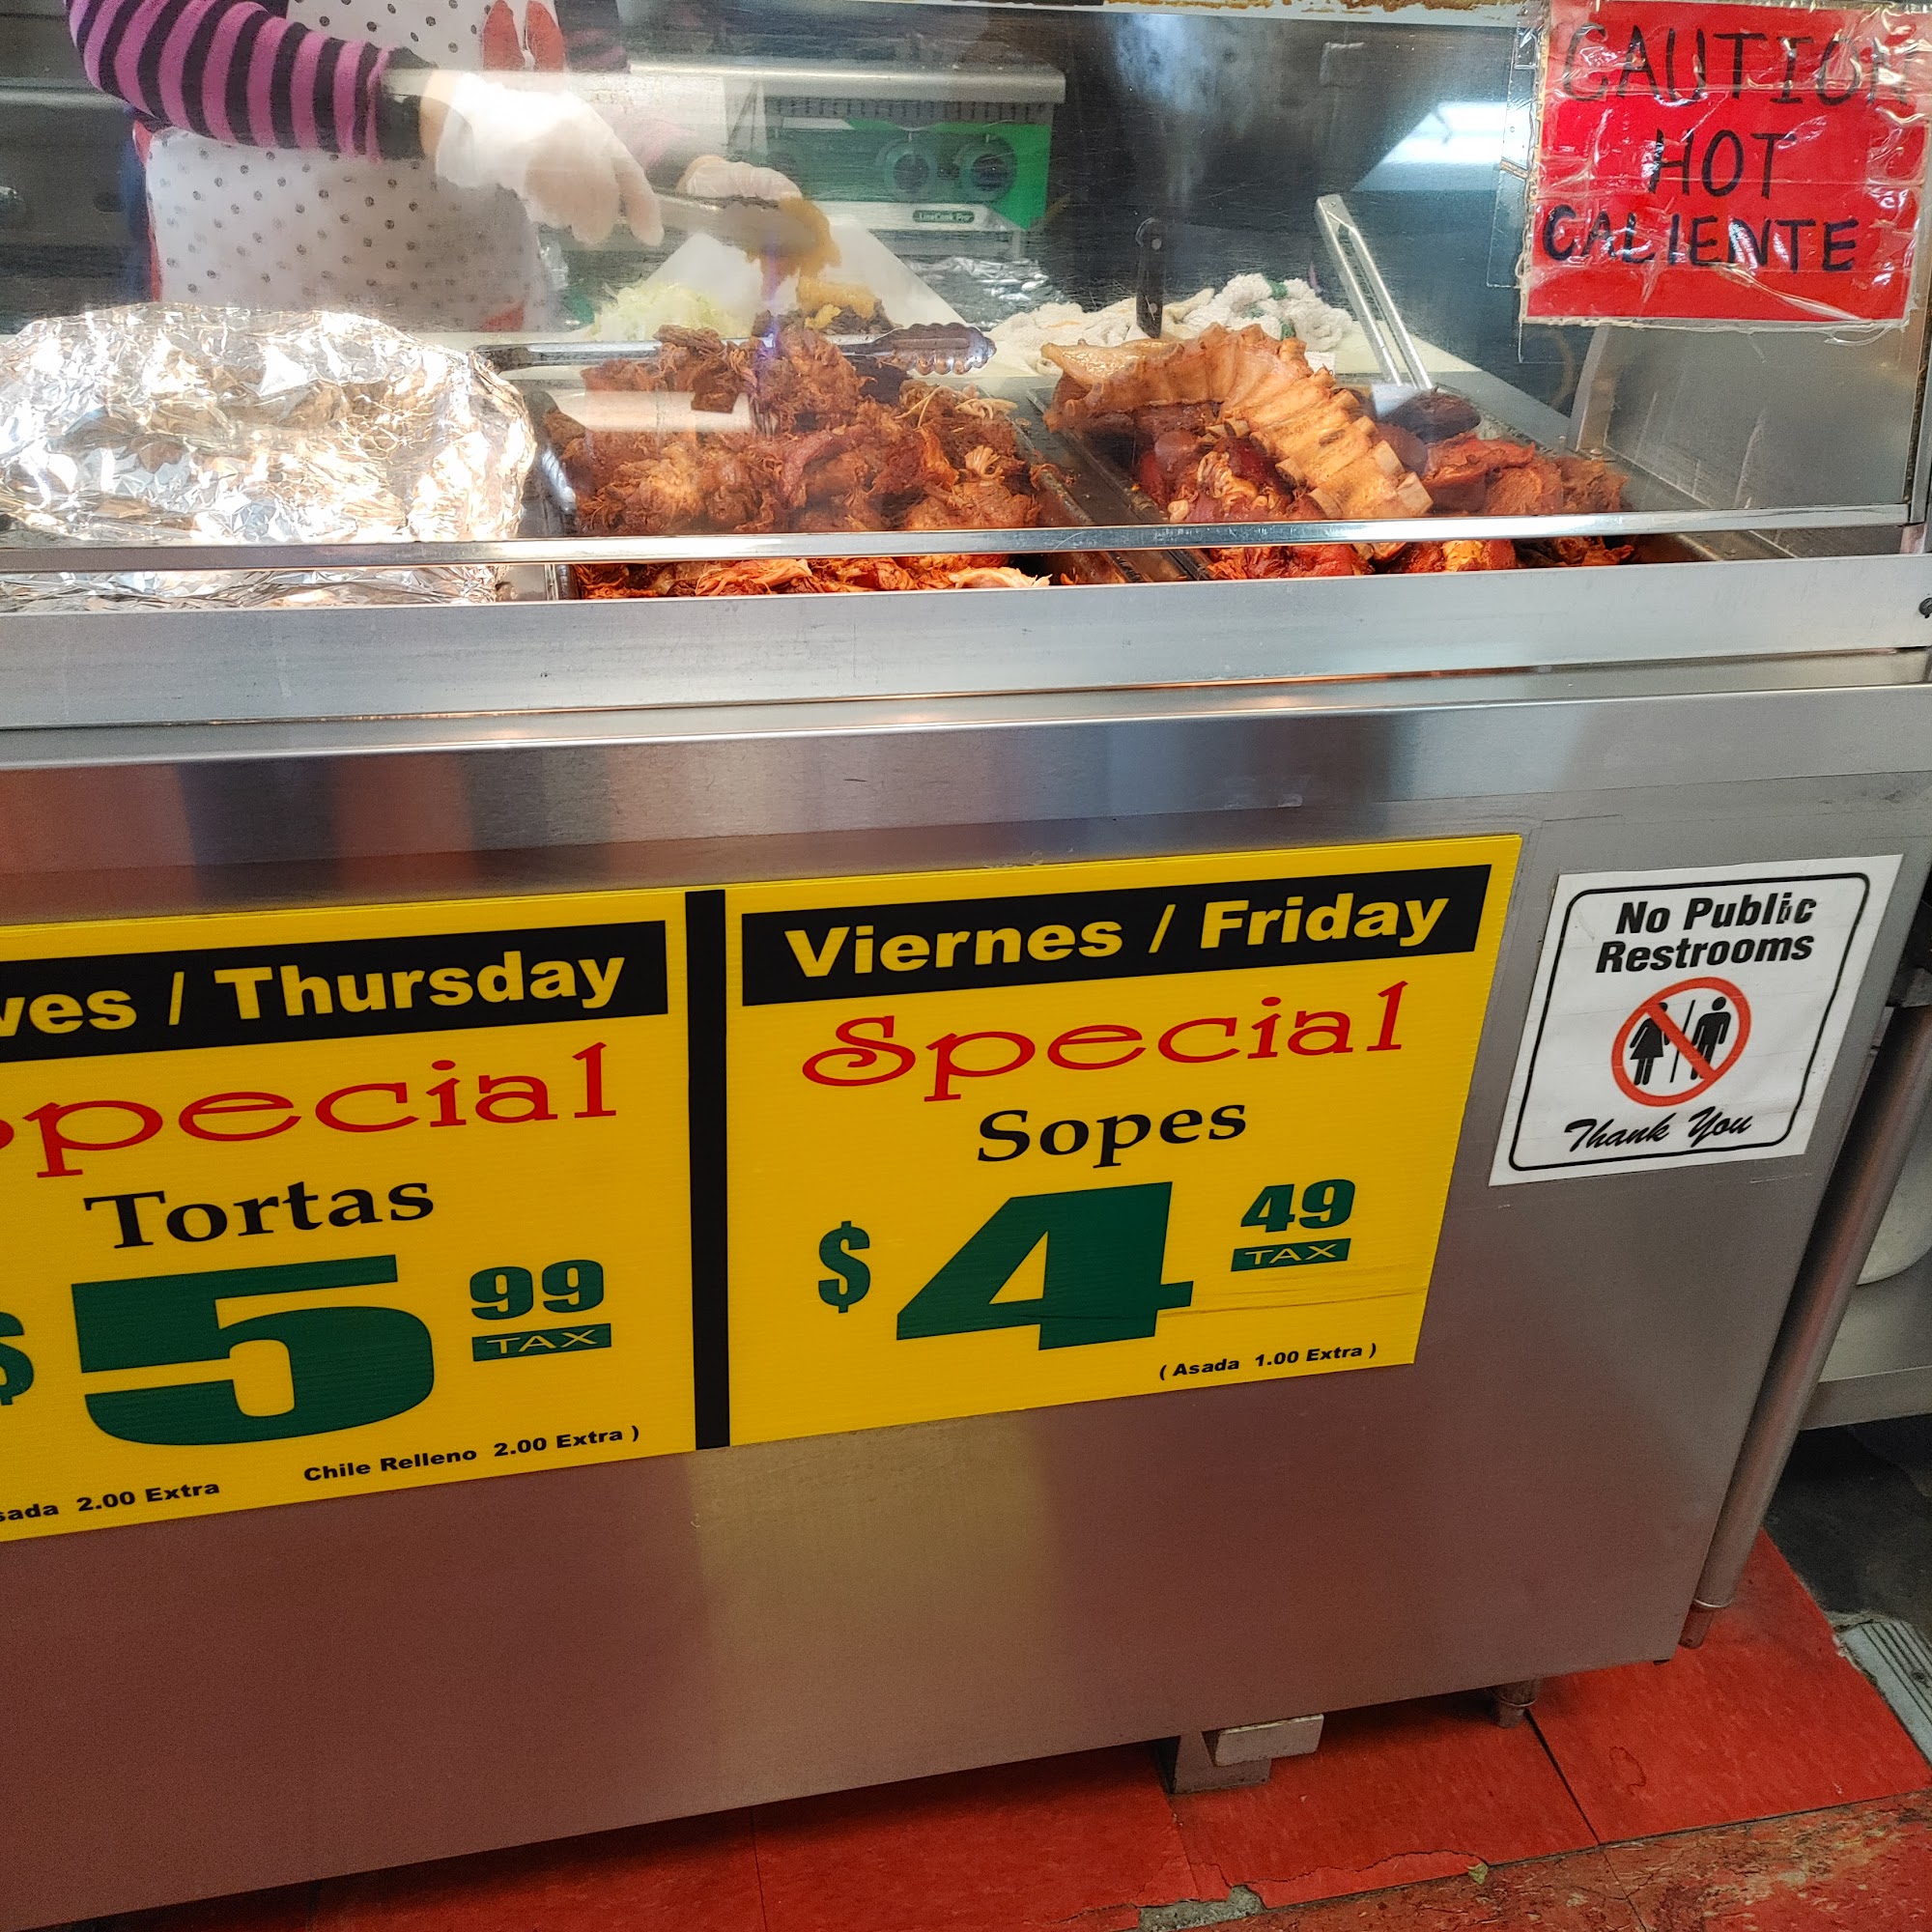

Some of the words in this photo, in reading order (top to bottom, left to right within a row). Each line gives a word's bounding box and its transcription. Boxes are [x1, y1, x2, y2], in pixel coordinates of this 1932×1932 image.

[1562, 23, 1909, 106] CAUTION
[1648, 128, 1797, 199] HOT
[1542, 204, 1859, 272] CALIENTE
[784, 923, 1123, 978] Viernes
[1150, 905, 1175, 952] /
[1202, 894, 1448, 948] Friday
[1616, 901, 1670, 934] No
[1684, 893, 1816, 930] Public
[170, 973, 184, 1024] /
[214, 951, 625, 1020] Thursday
[1595, 934, 1815, 974] Restrooms
[803, 981, 1406, 1101] Special
[0, 1042, 615, 1178] pecial
[979, 1105, 1245, 1168] Sopes
[1564, 1113, 1677, 1152] Thank
[1688, 1105, 1753, 1148] You
[84, 1180, 434, 1249] Tortas
[819, 1221, 870, 1313] $
[896, 1181, 1193, 1350] 4
[1241, 1179, 1355, 1233] 49
[1245, 1241, 1334, 1264] TAX
[71, 1254, 435, 1446] 5
[469, 1259, 605, 1321] 99
[489, 1329, 598, 1353] TAX
[1172, 1357, 1239, 1377] Asada
[1255, 1350, 1299, 1367] 1.00
[1306, 1346, 1363, 1362] Extra
[303, 1461, 371, 1482] Chile
[380, 1449, 477, 1472] Relleno
[494, 1435, 547, 1457] 2.00
[556, 1430, 623, 1449] Extra
[76, 1490, 135, 1512] 2.00
[145, 1483, 220, 1503] Extra
